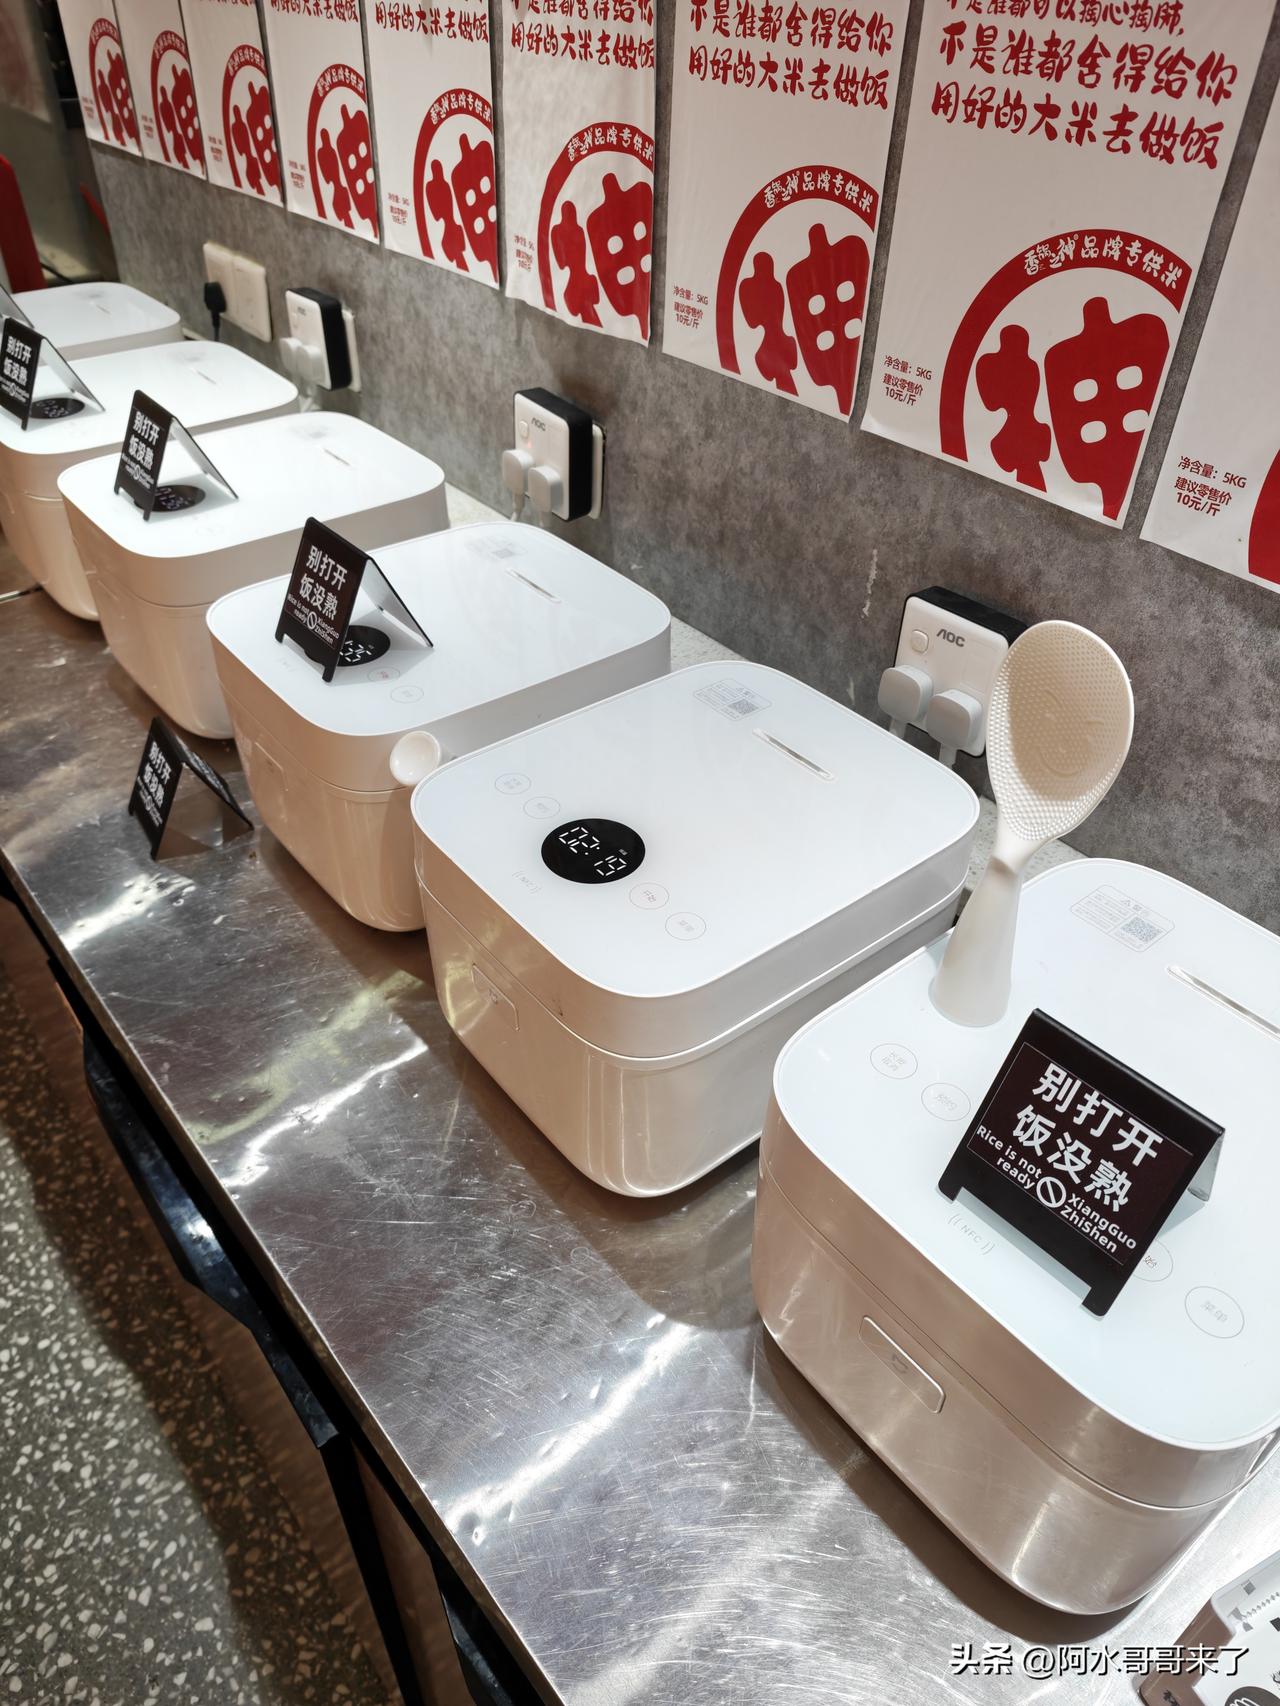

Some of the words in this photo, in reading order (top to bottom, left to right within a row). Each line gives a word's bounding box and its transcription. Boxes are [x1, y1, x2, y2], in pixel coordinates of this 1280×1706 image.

[375, 1, 489, 43] 用好的大米去做饭
[511, 21, 654, 70] 用好的大米去做饭
[690, 0, 894, 57] 不是谁都舍得给你
[689, 45, 889, 110] 用好的大米去做饭
[940, 21, 1237, 106] 不是谁都舍得给你
[931, 81, 1224, 169] 用好的大米去做饭
[883, 373, 924, 396] 建议零售价
[885, 386, 917, 406] 10元/斤
[133, 410, 160, 446] 别打开
[1174, 476, 1233, 506] 建议零售价
[1176, 492, 1221, 517] 10元/斤
[306, 545, 348, 591] 别打开
[299, 573, 338, 621] 饭没熟
[936, 628, 965, 648] AOC
[1032, 1062, 1164, 1168] 别打开
[976, 1125, 1004, 1151] Rice
[1004, 1145, 1018, 1160] is
[1018, 1158, 1042, 1179] not
[996, 1157, 1036, 1190] ready
[1011, 1104, 1135, 1213] 饭没熟
[1067, 1193, 1137, 1249] XiangGuo
